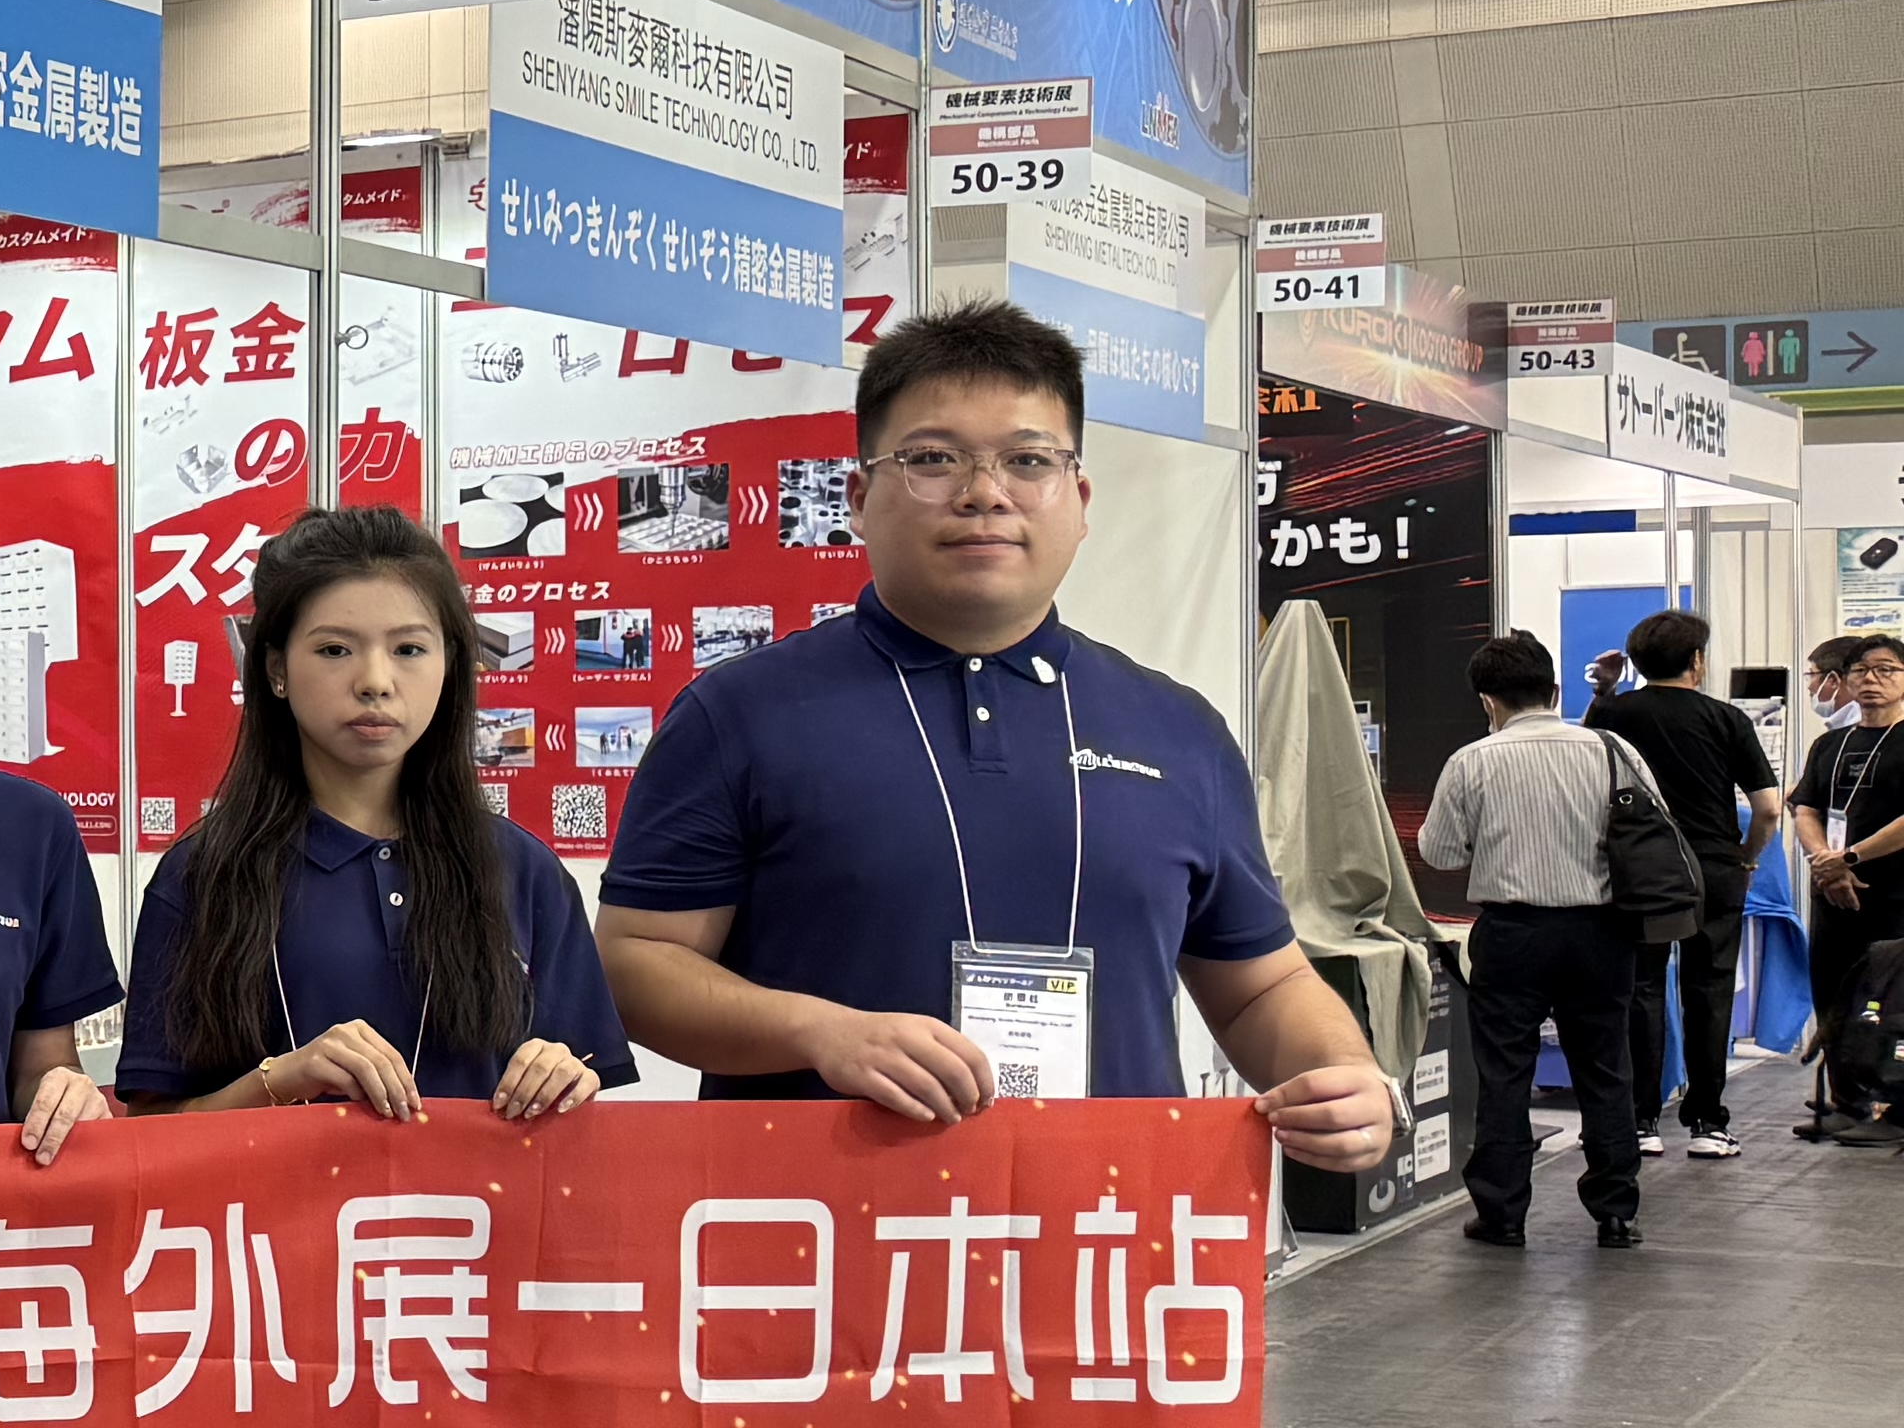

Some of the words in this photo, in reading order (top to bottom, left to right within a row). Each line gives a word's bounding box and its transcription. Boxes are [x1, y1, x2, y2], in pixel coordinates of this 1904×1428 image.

[522, 51, 610, 109] SHENYANG
[615, 80, 658, 124] SMILE
[664, 96, 758, 155] TECHNOLOGY
[762, 129, 789, 168] CO.,
[793, 139, 820, 172] LTD.
[946, 86, 1072, 108] 機械要素技術展
[952, 159, 1064, 194] 50-39
[501, 178, 834, 310] せいみつきんぞくせいぞう精密金属製造
[1046, 222, 1092, 260] SHENYANG
[1274, 275, 1360, 302] 50-41
[141, 300, 305, 390] 板金
[1450, 337, 1484, 373] GROUP
[1520, 349, 1595, 371] 50-43
[450, 436, 707, 469] 機械加工部品のプロセス
[1051, 980, 1075, 990] VIP
